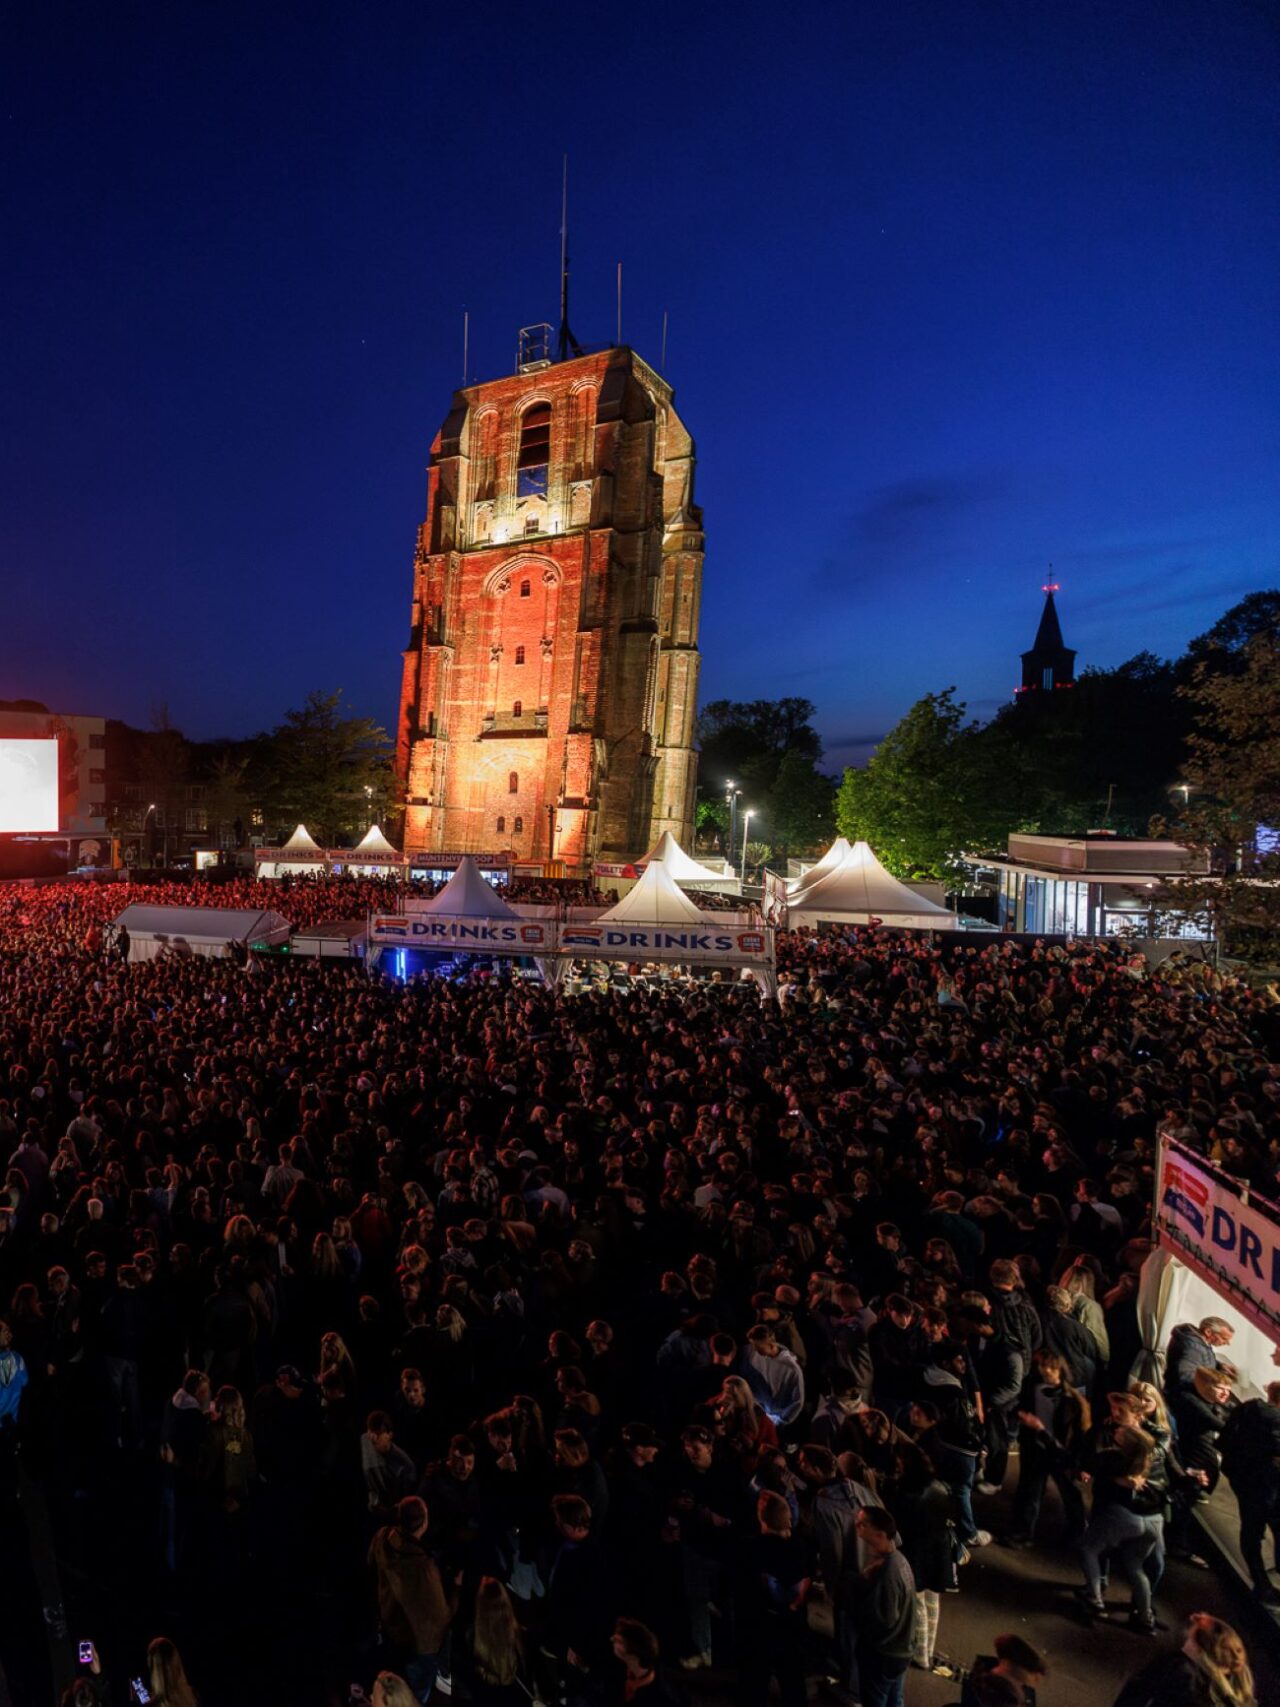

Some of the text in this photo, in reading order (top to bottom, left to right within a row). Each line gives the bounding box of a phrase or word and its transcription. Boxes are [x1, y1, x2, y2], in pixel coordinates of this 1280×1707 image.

[271, 851, 315, 859] DRINKS
[346, 853, 392, 861] DRINKS
[418, 854, 492, 864] MUNTENVEOOP
[412, 923, 517, 941] DRINKS
[607, 932, 734, 951] DRINKS
